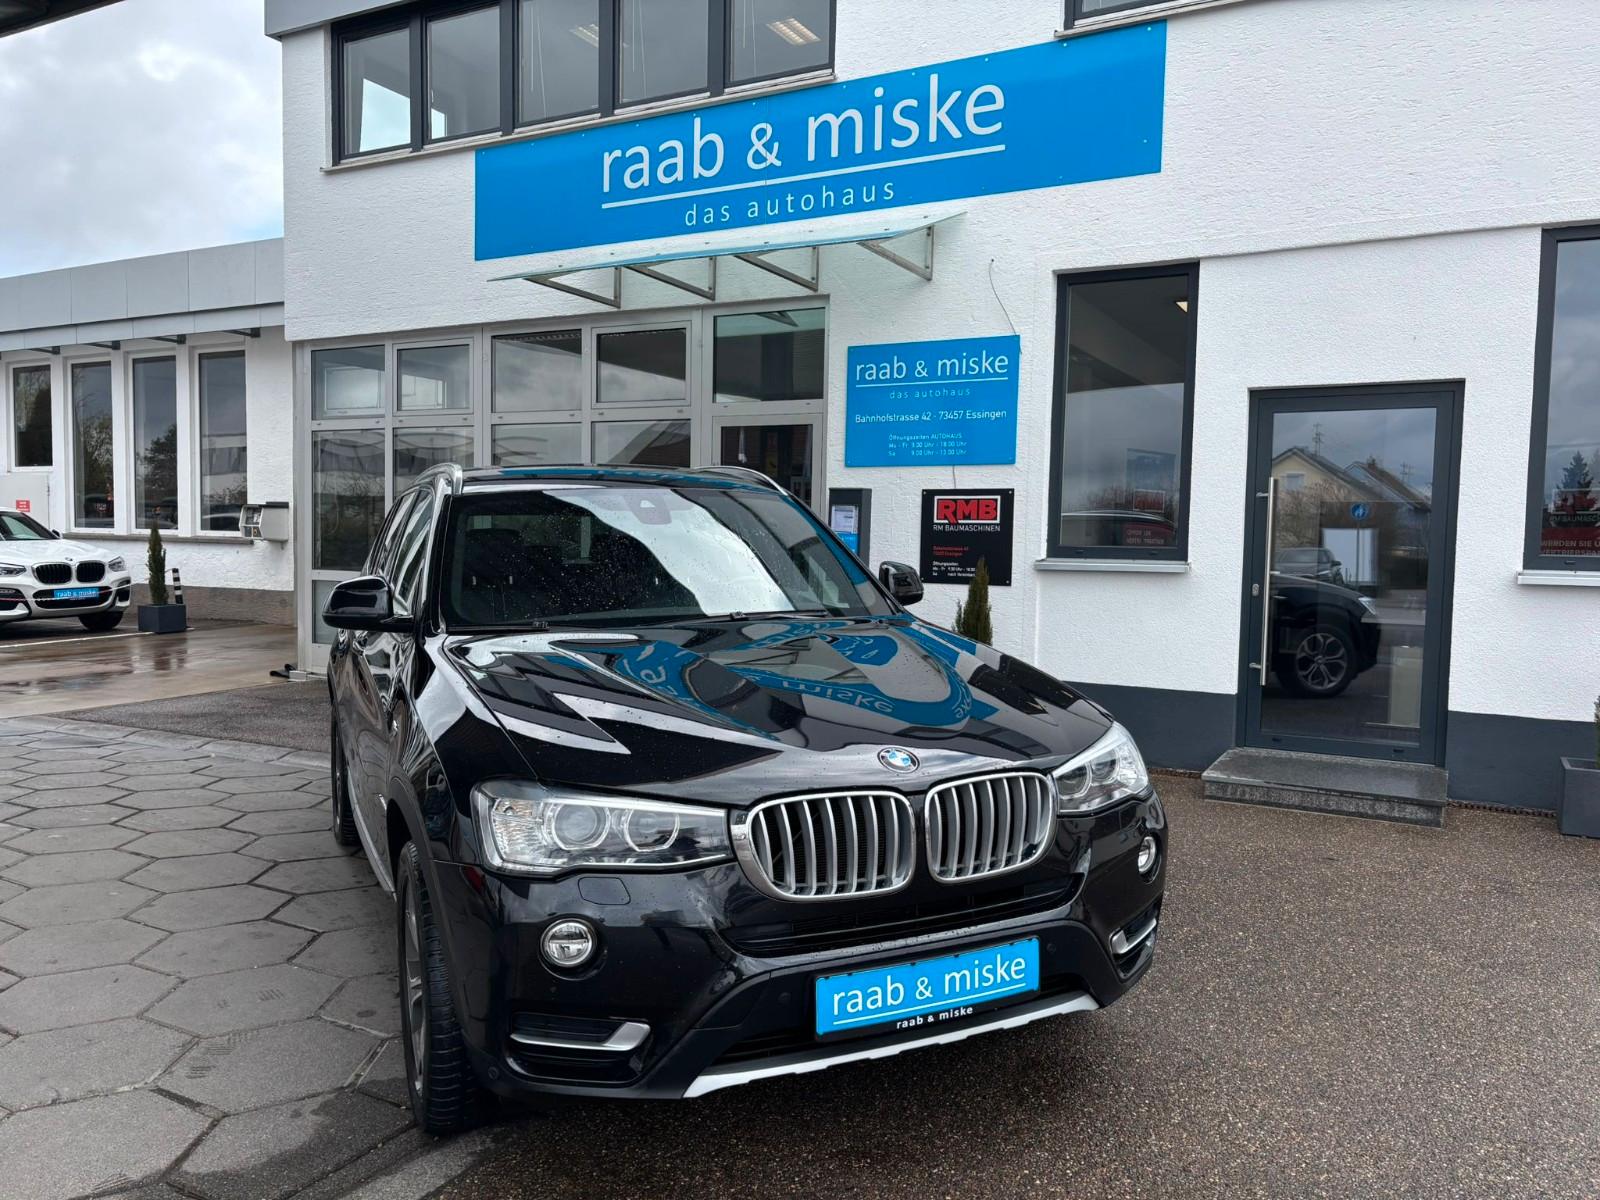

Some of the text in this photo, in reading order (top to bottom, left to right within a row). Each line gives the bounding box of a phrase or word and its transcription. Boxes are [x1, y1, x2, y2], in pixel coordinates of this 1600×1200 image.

[602, 73, 1005, 193] raab & miske
[685, 181, 895, 226] das autohaus
[856, 350, 1009, 381] raab & miske
[889, 387, 971, 399] das autohaus
[855, 411, 919, 424] Bahnhofstrasse
[921, 411, 931, 421] 42
[938, 410, 963, 420] 73457
[966, 409, 1007, 421] Essingen
[930, 432, 962, 440] AUTOHAUS
[937, 499, 996, 525] RMB
[945, 524, 1001, 532] BAUMASCHINEN
[833, 953, 1026, 1016] raab & miske
[896, 1005, 974, 1030] raab & miske
